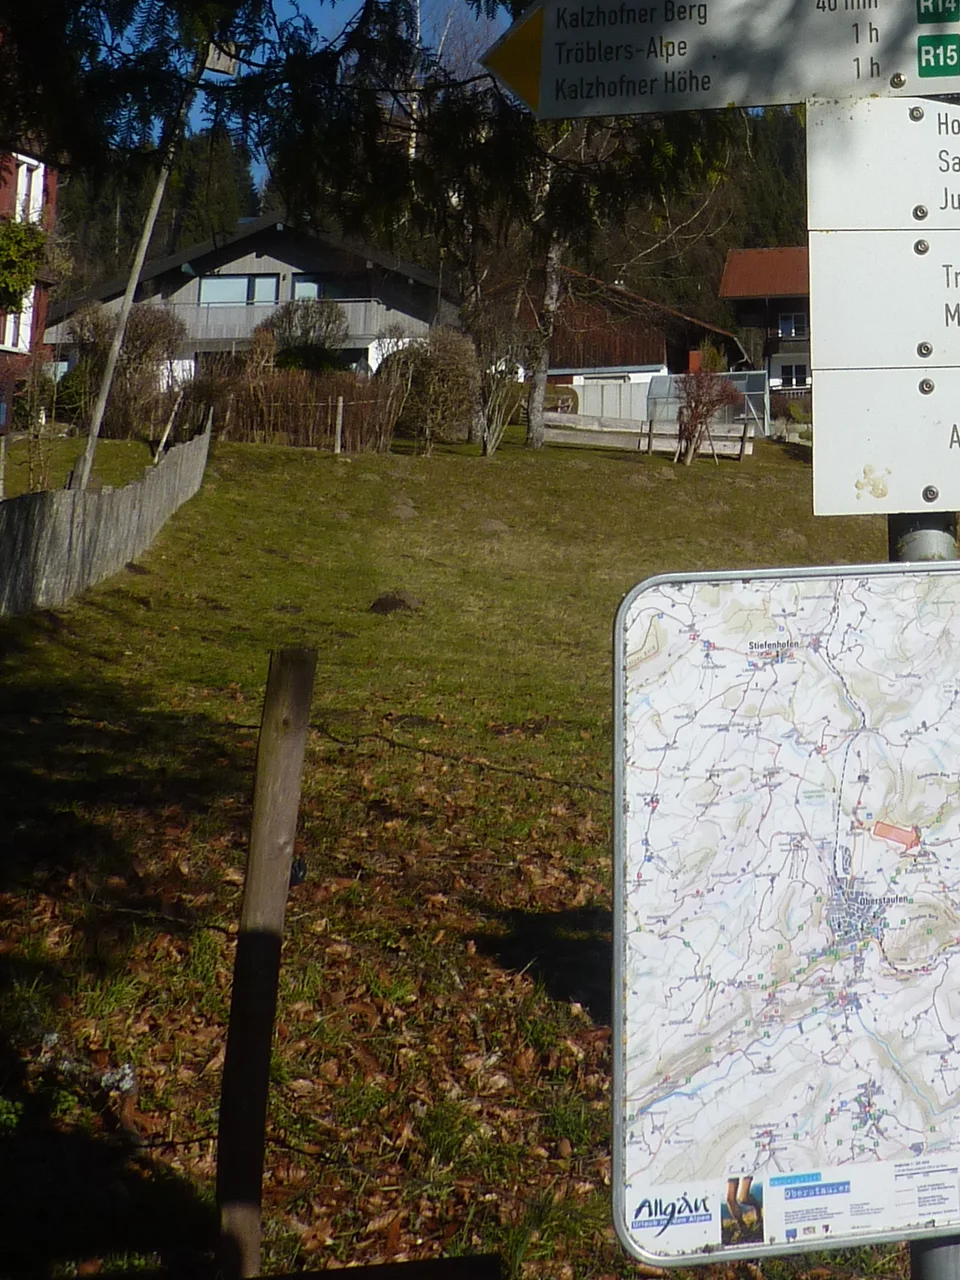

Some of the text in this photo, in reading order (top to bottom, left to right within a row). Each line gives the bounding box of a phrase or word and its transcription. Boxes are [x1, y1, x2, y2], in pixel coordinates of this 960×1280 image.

[556, 0, 708, 29] Kalzhofner Berg
[555, 36, 688, 65] Tröblers-Alpe
[920, 44, 958, 68] R15
[555, 71, 711, 101] Kalzhofner Höhe
[749, 640, 799, 650] Stiefenhofen
[859, 894, 909, 906] Oberstaufen
[634, 1191, 710, 1238] Allgäu
